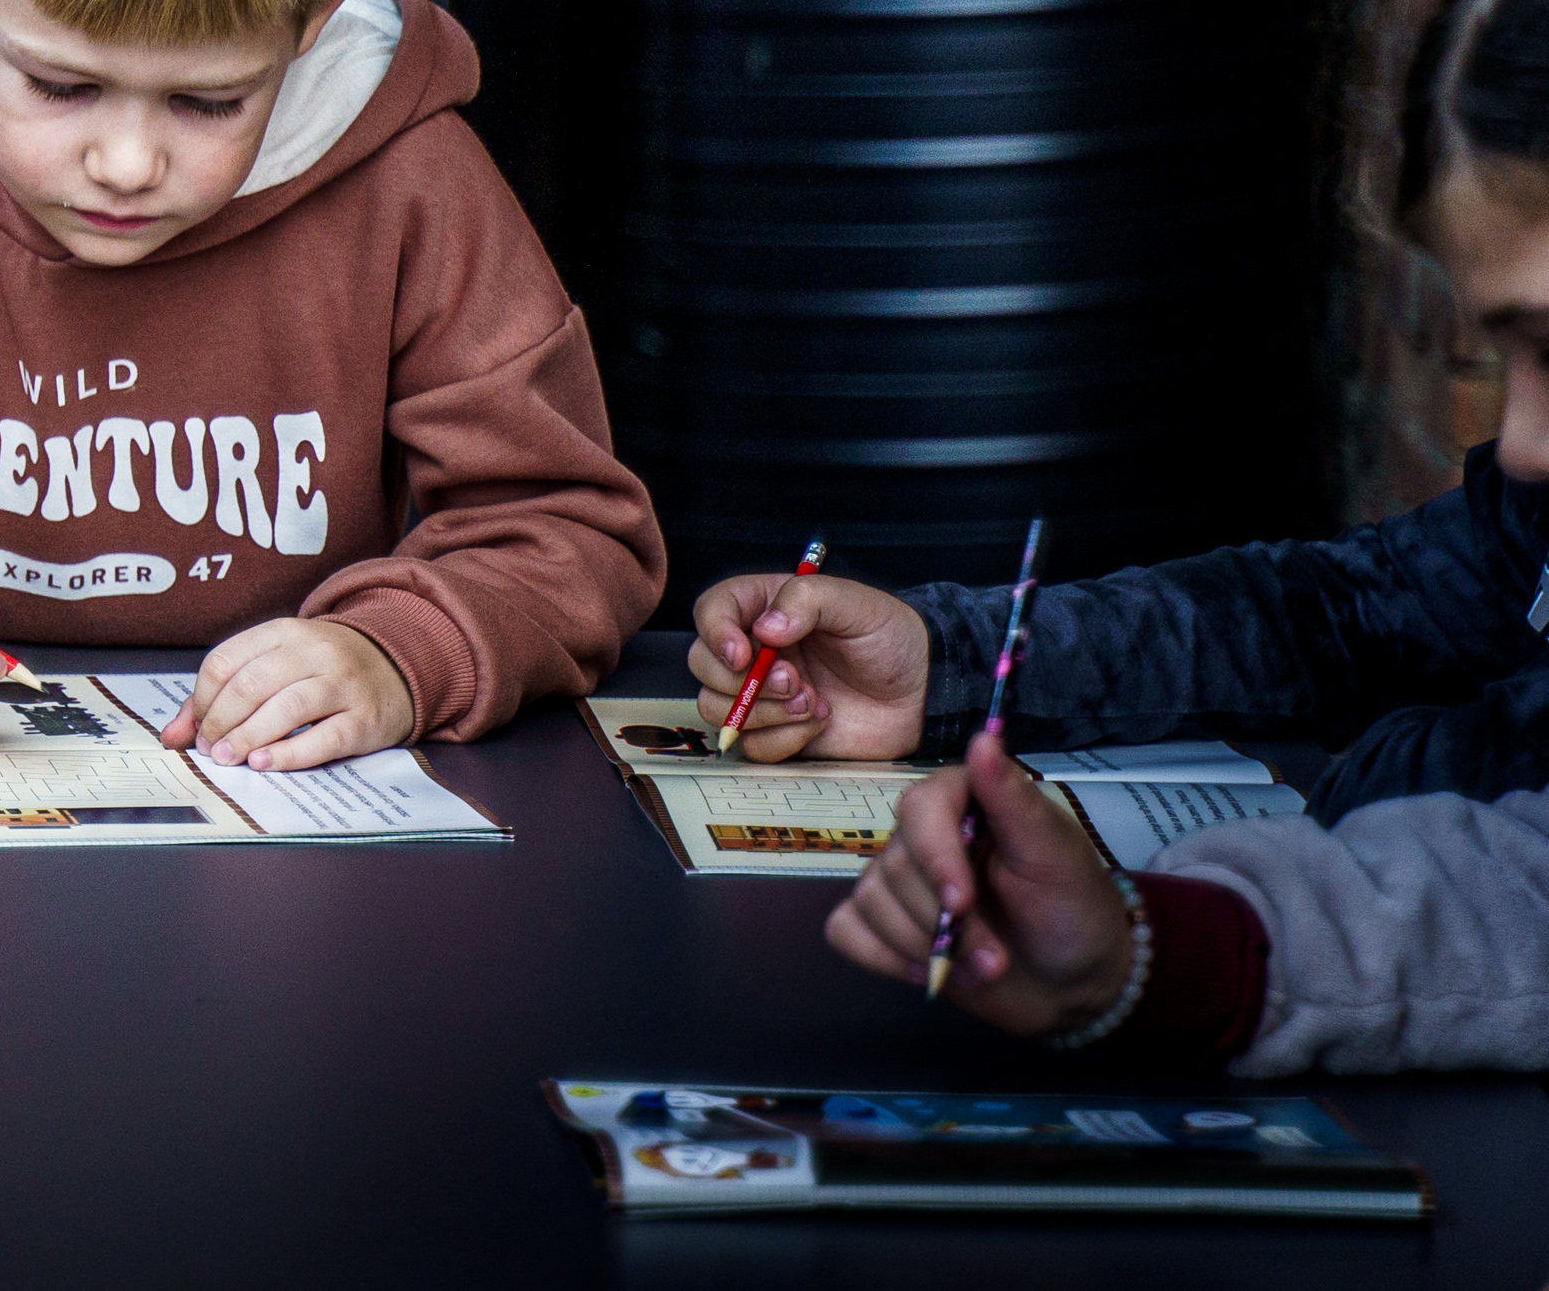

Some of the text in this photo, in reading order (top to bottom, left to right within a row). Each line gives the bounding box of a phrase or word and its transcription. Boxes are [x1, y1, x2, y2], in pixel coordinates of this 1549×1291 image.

[18, 358, 140, 407] WILD
[188, 553, 234, 583] 47
[741, 679, 759, 706] voltom
